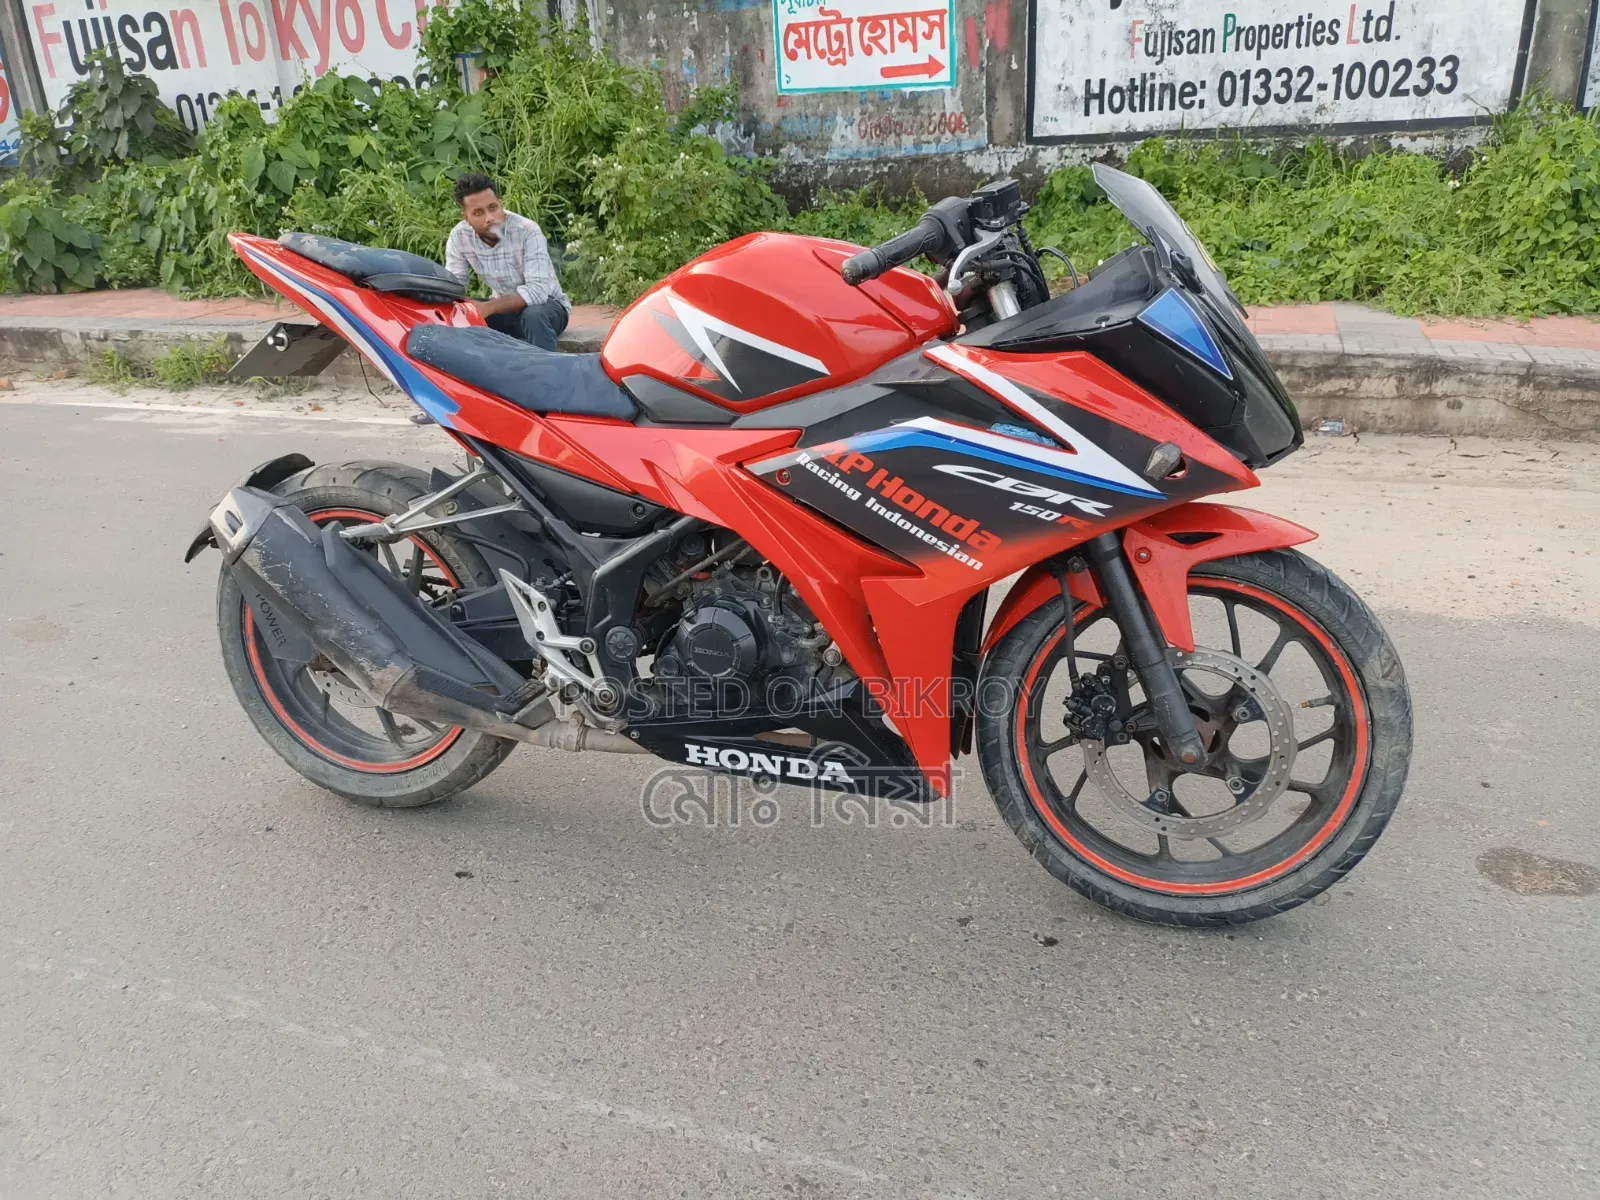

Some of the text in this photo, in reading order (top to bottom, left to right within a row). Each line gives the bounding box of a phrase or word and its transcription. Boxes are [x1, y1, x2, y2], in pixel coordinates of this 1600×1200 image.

[784, 6, 947, 67] মেট্রো হোমস
[1129, 0, 1401, 65] Fujisan Properties Ltd.
[1084, 54, 1460, 117] Hotline: 01332-100233
[795, 452, 984, 571] Racing Indonesian
[866, 468, 1003, 553] Honda
[932, 464, 1113, 517] CBR
[1009, 501, 1093, 529] 150R
[684, 743, 854, 783] HONDA
